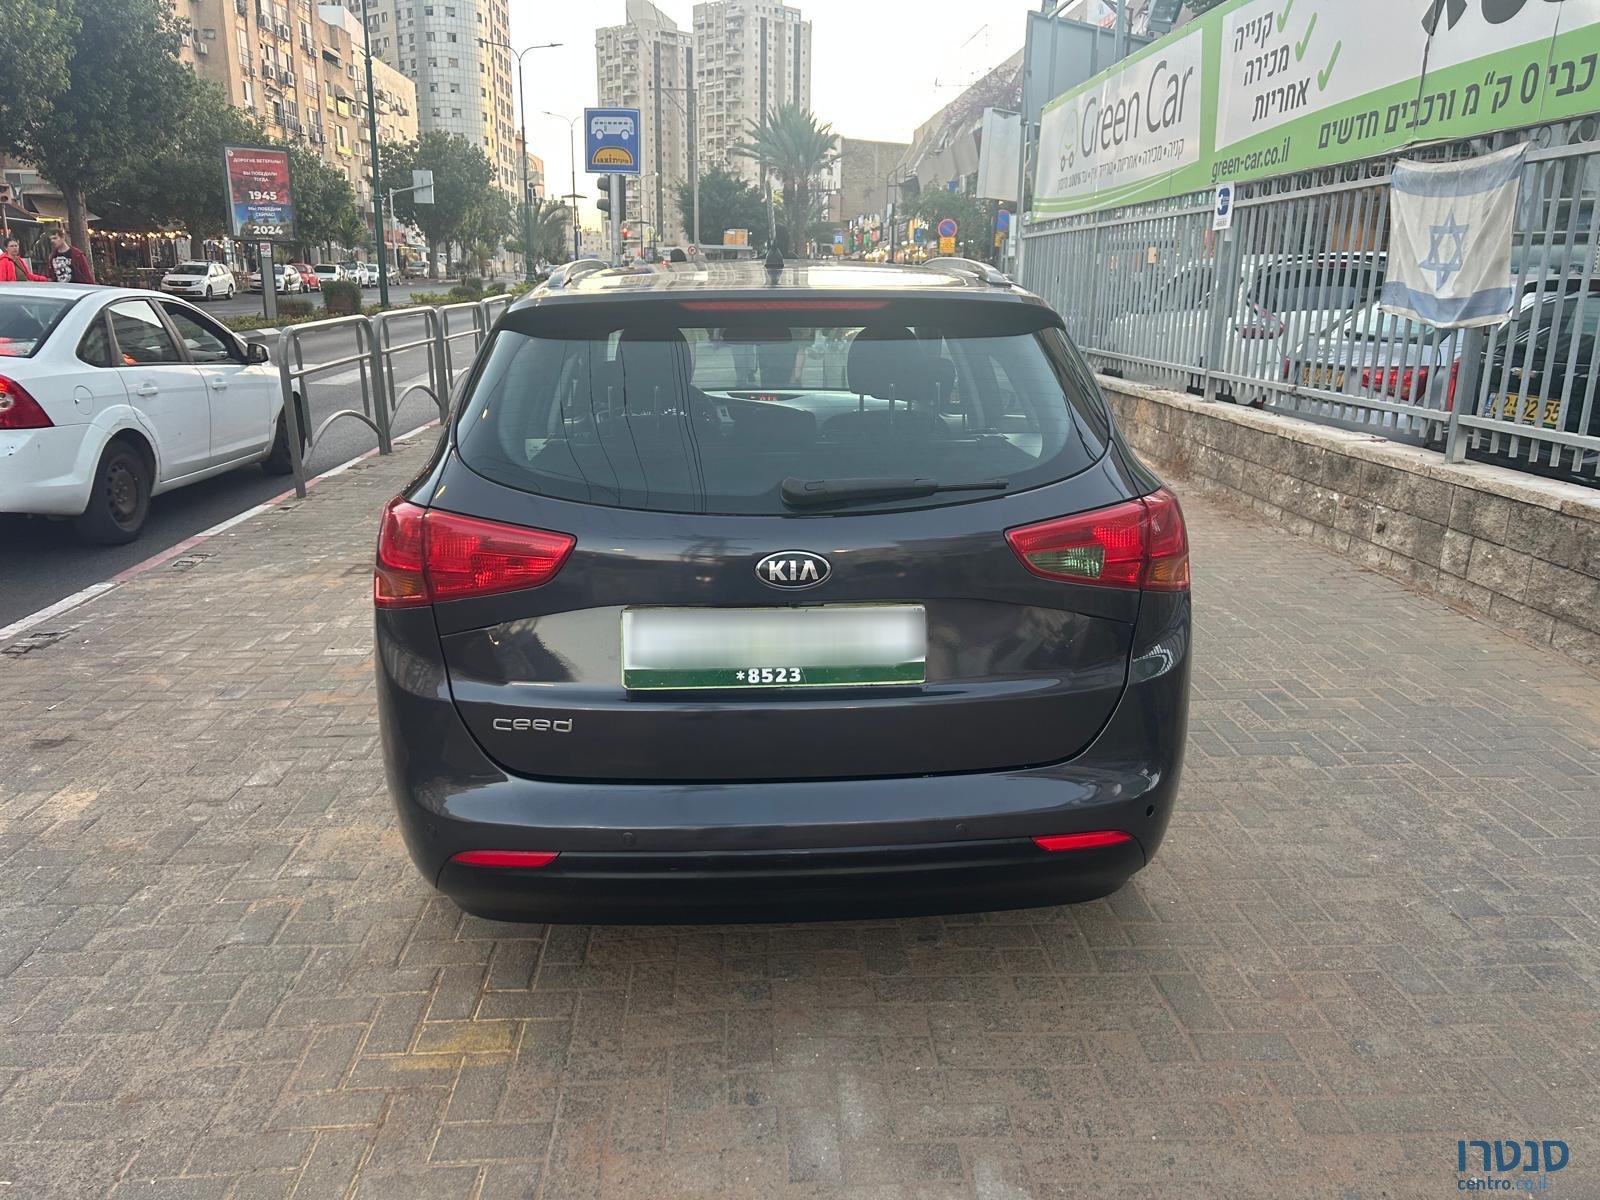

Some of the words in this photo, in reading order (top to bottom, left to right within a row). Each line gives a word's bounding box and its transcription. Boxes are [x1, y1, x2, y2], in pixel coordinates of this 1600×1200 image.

[1234, 11, 1274, 52] קנייה
[1244, 44, 1290, 86] מכירה
[1081, 91, 1141, 158] Green
[1146, 60, 1194, 133] Car
[1252, 77, 1311, 122] אחריות
[1384, 89, 1456, 134] ורכבים
[1318, 110, 1379, 149] חדשים
[1211, 136, 1291, 183] green-car.co.il
[248, 190, 278, 201] 1945
[252, 225, 284, 235] 2024
[768, 560, 819, 581] KIA
[492, 717, 573, 733] ceed
